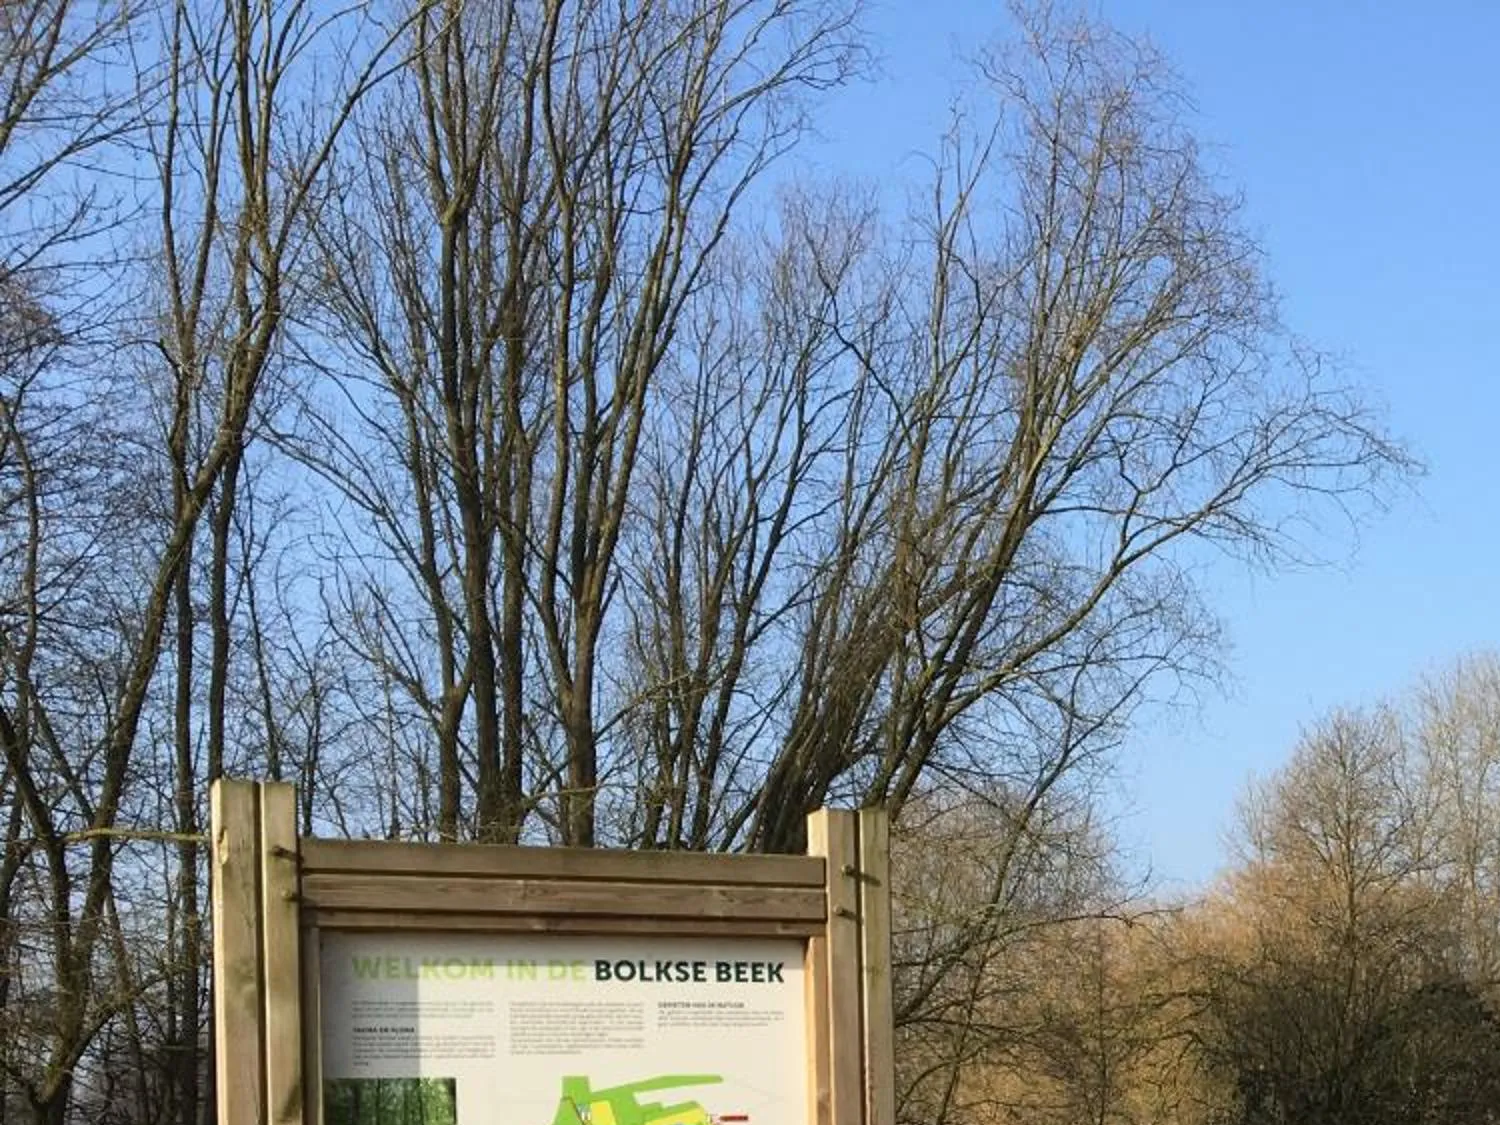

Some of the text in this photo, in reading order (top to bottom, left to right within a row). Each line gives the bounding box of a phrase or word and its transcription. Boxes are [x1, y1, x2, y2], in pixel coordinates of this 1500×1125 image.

[352, 957, 784, 983] WELKOM IN DE BOLKSE BEEK
